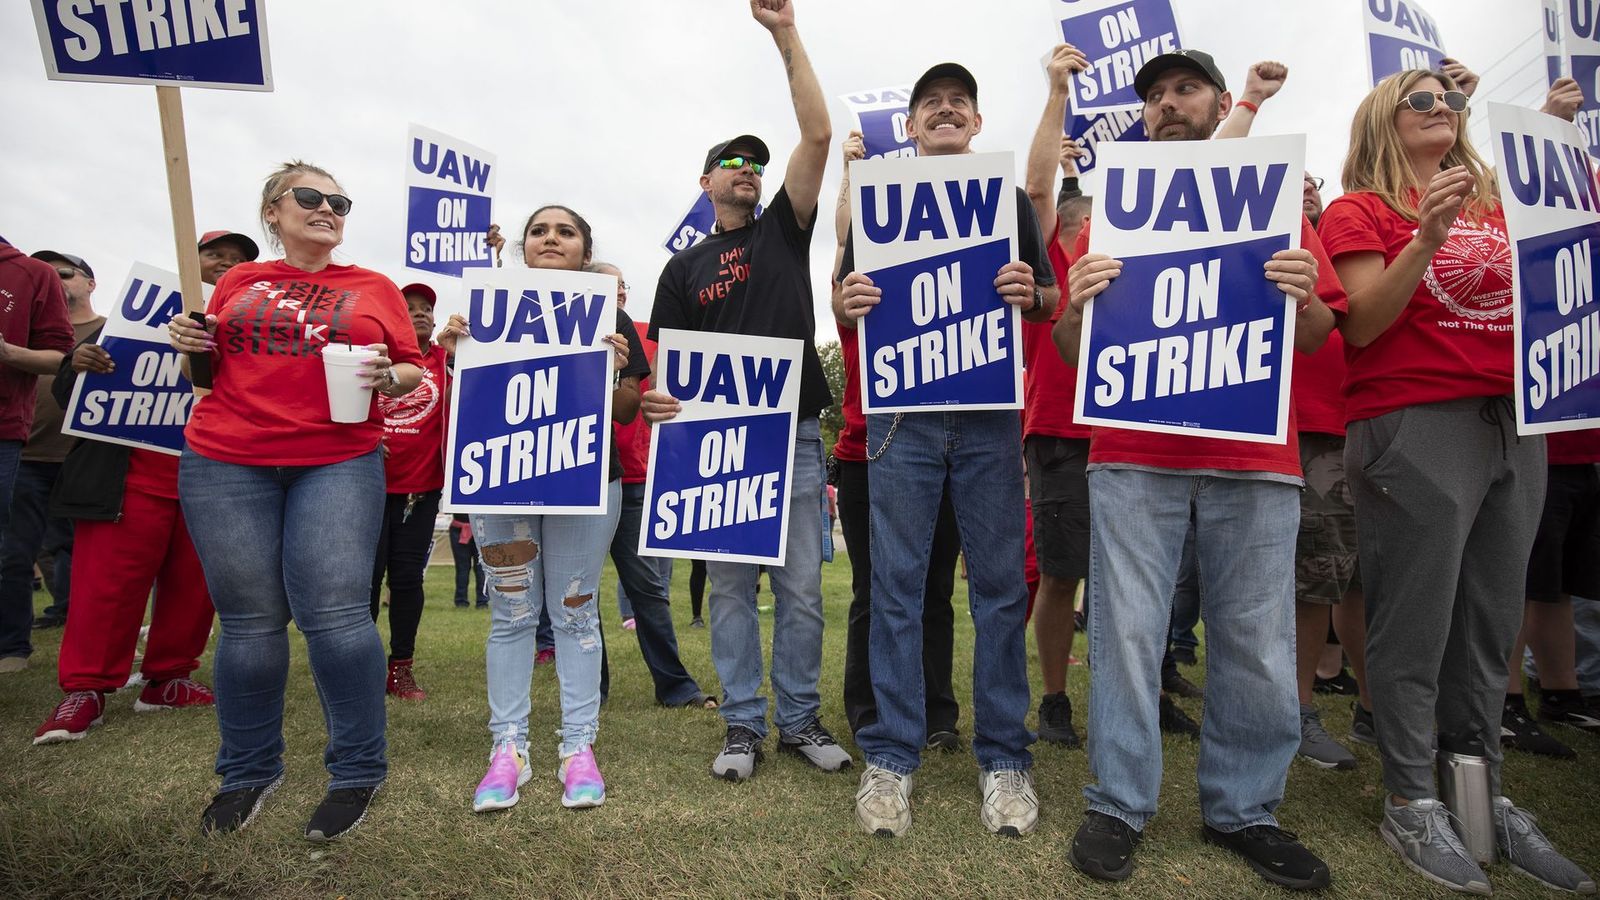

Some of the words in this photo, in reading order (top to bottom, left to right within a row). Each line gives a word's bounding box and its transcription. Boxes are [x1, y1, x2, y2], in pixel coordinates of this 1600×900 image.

[57, 0, 250, 62] STRIKE
[1099, 6, 1141, 49] ON
[1368, 0, 1440, 49] UAW
[1400, 47, 1431, 72] ON
[891, 112, 910, 143] O
[413, 137, 491, 193] UAW
[1502, 132, 1600, 213] UAW
[437, 198, 467, 229] ON
[860, 177, 1004, 244] UAW
[1104, 163, 1289, 232] UAW
[410, 232, 488, 264] STRIKE
[1439, 268, 1464, 279] VISION
[1440, 246, 1469, 259] MEDICAL
[121, 278, 183, 329] UA
[911, 261, 963, 326] ON
[1152, 258, 1221, 329] ON
[1480, 298, 1506, 308] PROFIT
[1555, 238, 1593, 316] ON
[468, 289, 606, 347] UAW
[1437, 320, 1460, 329] Not
[1463, 321, 1485, 330] The
[131, 351, 183, 387] ON
[226, 336, 323, 357] STRIK
[873, 307, 1007, 399] STRIKE
[1094, 316, 1274, 408] STRIKE
[1528, 309, 1600, 410] STRI
[505, 366, 559, 426] ON
[666, 349, 792, 409] UAW
[80, 390, 195, 426] STRIK
[458, 413, 597, 496] STRIKE
[698, 425, 747, 478] ON
[654, 471, 780, 540] STRIKE
